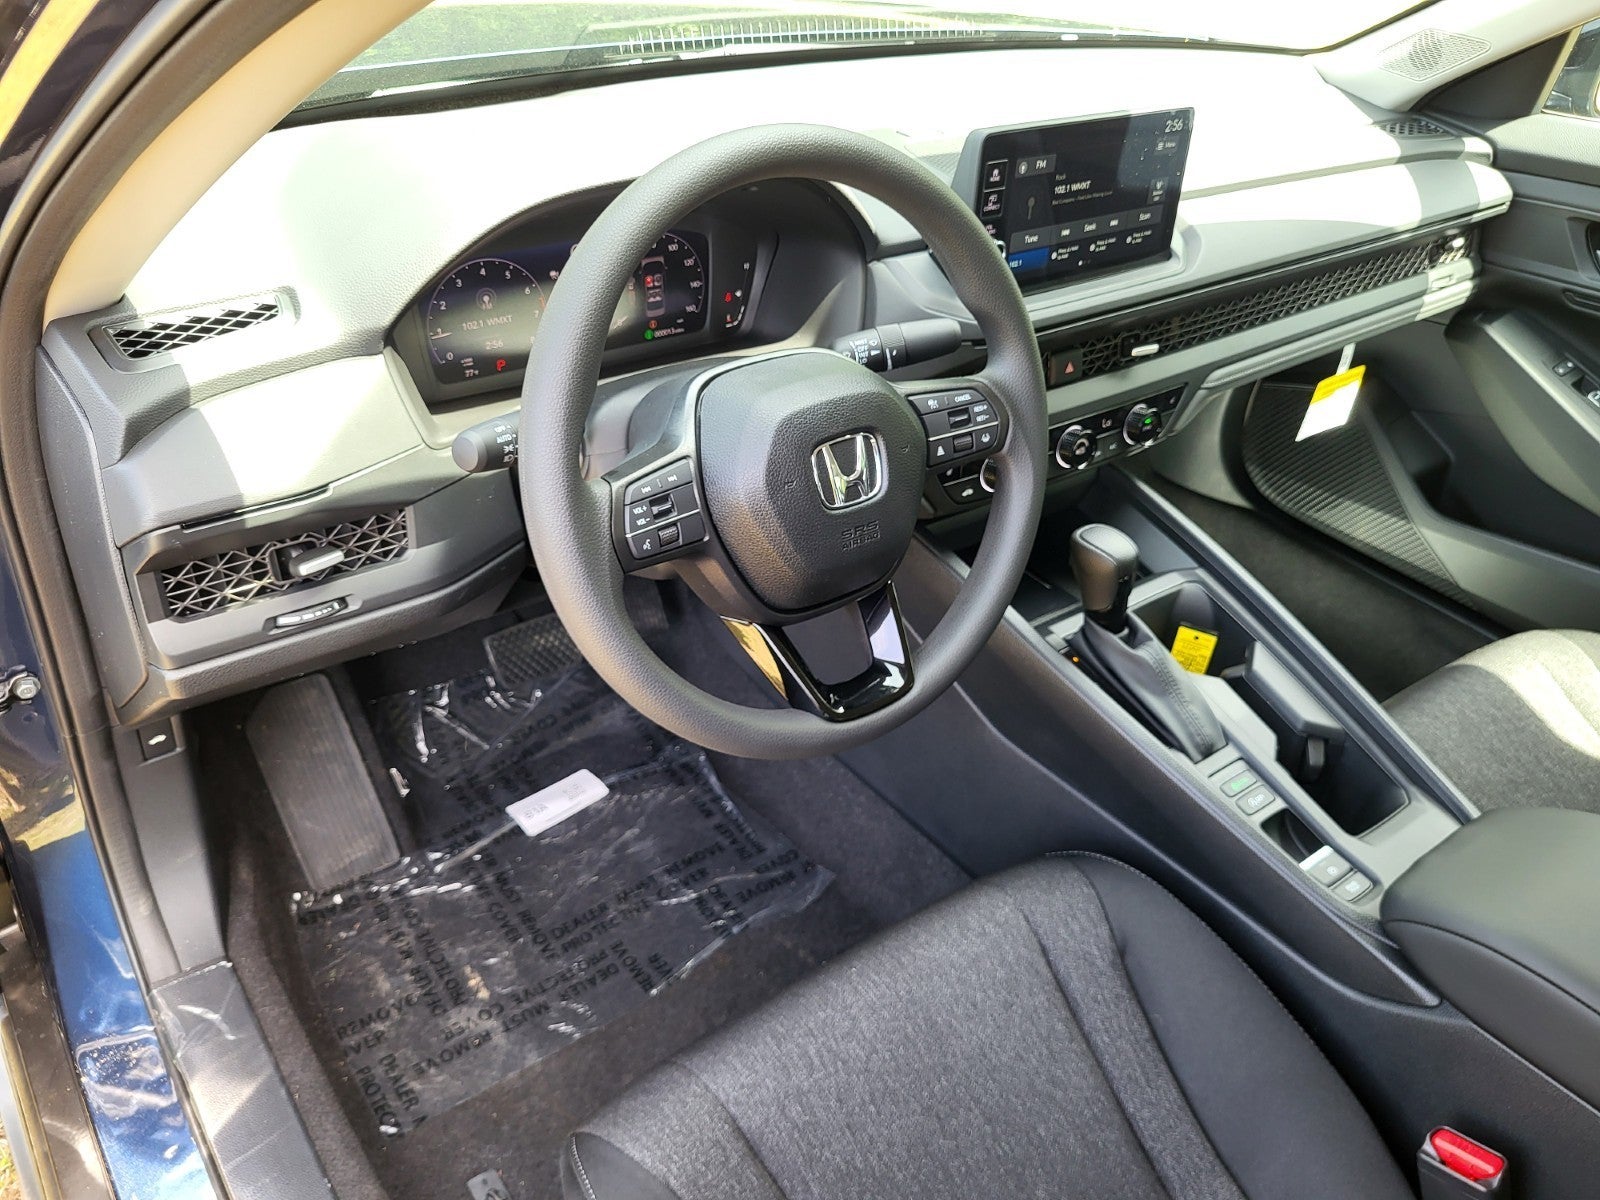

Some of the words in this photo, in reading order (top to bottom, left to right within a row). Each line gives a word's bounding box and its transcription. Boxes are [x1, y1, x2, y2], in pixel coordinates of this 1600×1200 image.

[1164, 119, 1184, 132] 2:56
[1036, 160, 1047, 170] FM
[1054, 184, 1070, 194] 102.1
[1024, 234, 1038, 244] Tune
[1084, 222, 1096, 232] Seek
[668, 244, 678, 252] 100
[684, 258, 695, 267] 120
[480, 268, 486, 276] 4
[505, 270, 511, 280] 5
[456, 279, 462, 288] 3
[524, 286, 530, 294] 6
[440, 301, 446, 310] 2
[462, 320, 484, 331] 102.1
[486, 315, 512, 326] WMXT
[486, 340, 504, 350] 2:56
[446, 352, 454, 360] 0
[496, 358, 506, 372] P
[954, 394, 972, 402] CANCEL
[496, 434, 512, 444] AUTO
[842, 520, 879, 540] SRS
